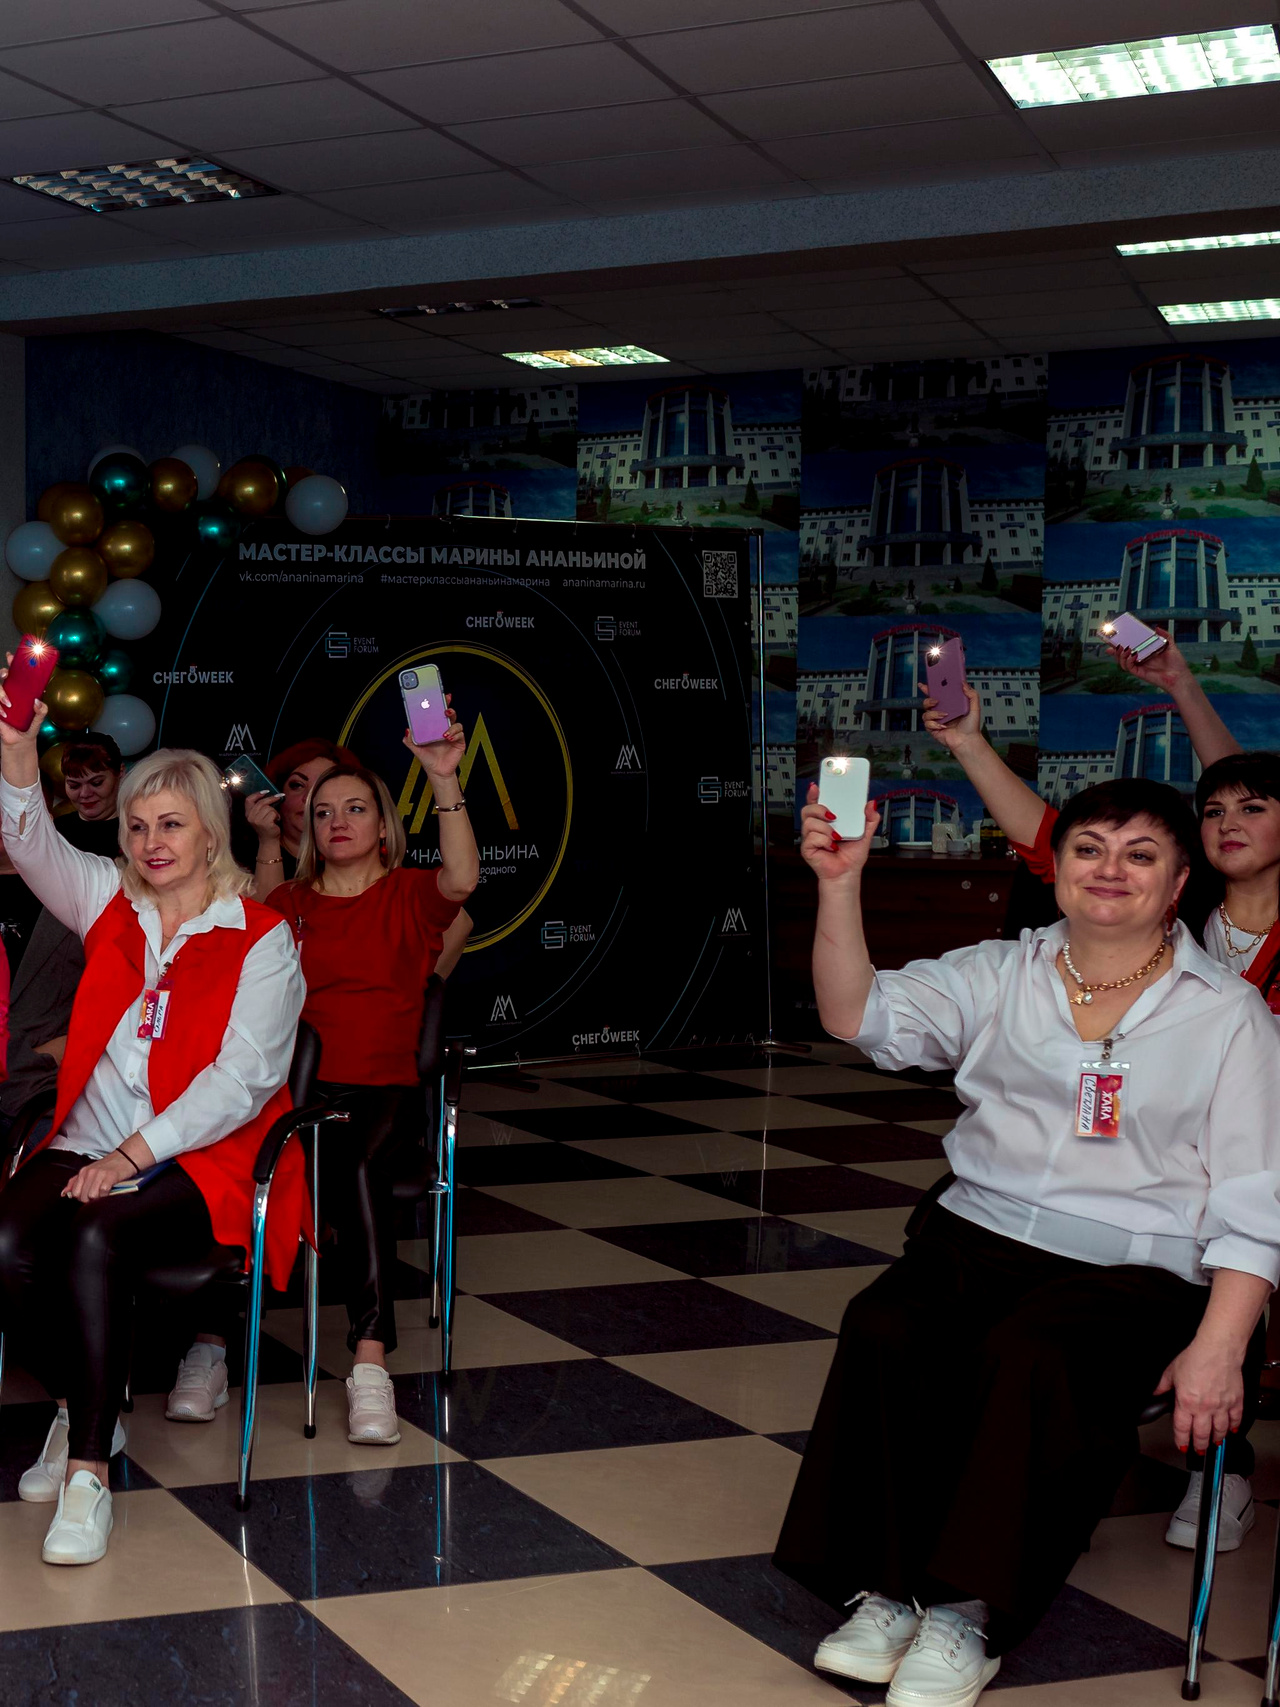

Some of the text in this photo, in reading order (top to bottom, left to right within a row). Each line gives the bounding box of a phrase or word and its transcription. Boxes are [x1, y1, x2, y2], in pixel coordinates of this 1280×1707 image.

[238, 542, 646, 569] МАСТЕР-КЛАССЫ МАРИНЫ АНАНЬИНОЙ
[239, 570, 364, 584] vk.com/ananinamarina
[380, 573, 550, 587] #мастерклассыананьинамарина
[562, 577, 646, 589] ananinamarina.ru
[619, 621, 638, 629] EVENT
[619, 628, 642, 637] FORUM
[353, 637, 376, 645] EVENT
[353, 645, 380, 654] FORUM
[724, 781, 745, 790] EVENT
[724, 789, 749, 798] FORUM
[479, 865, 517, 875] РОДНОГО
[570, 924, 592, 933] EVENT
[570, 933, 596, 942] FORUM
